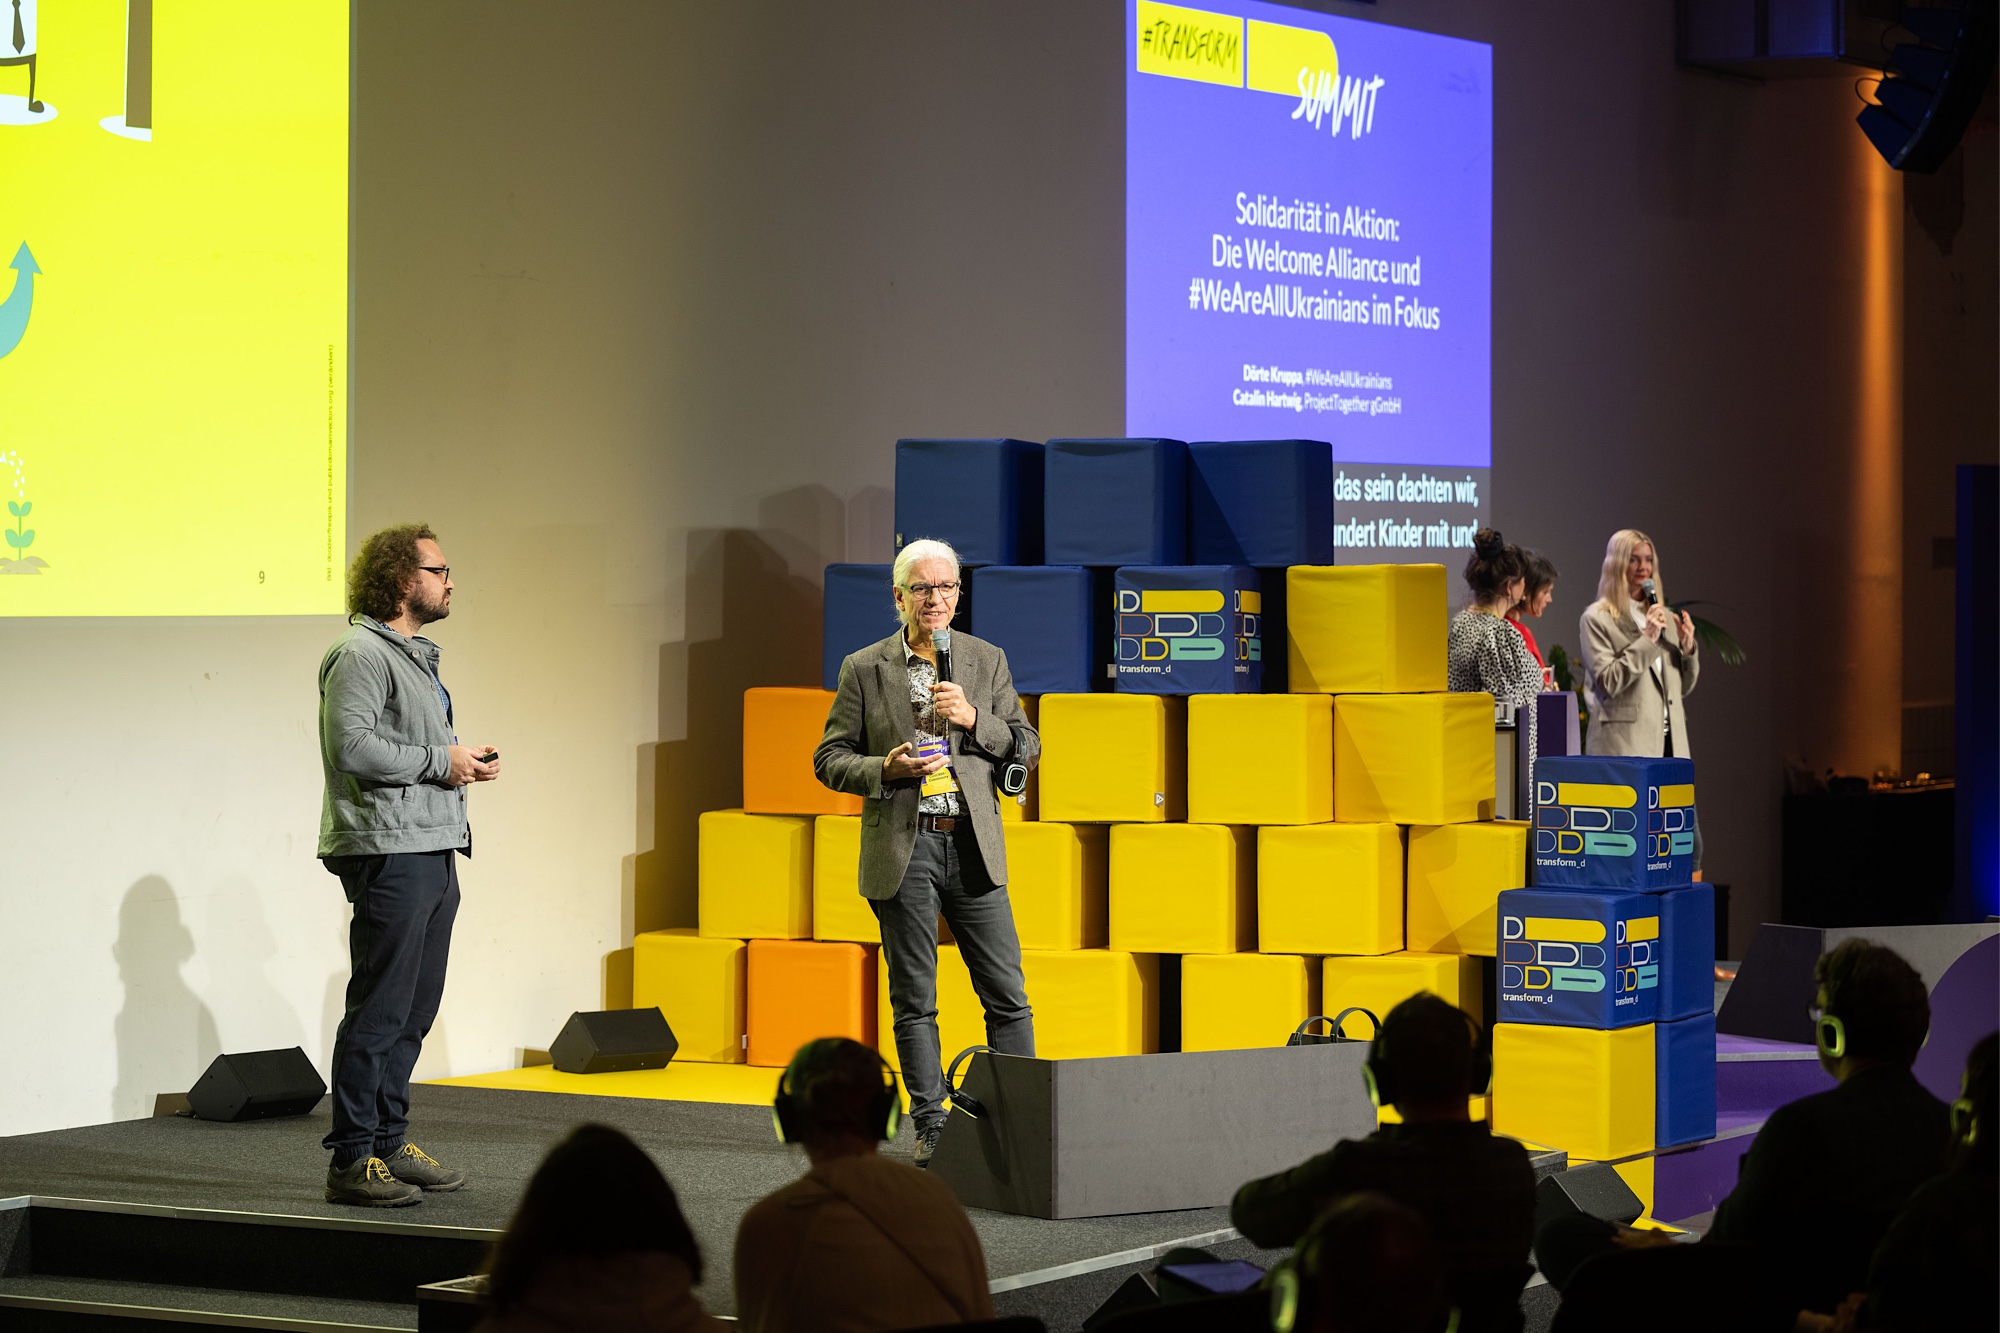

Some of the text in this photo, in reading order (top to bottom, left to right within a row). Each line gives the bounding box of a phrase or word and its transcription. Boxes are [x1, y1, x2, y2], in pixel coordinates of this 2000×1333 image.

[1142, 17, 1238, 74] #TRANSFORM
[1291, 66, 1385, 140] SUMMIT
[1235, 191, 1400, 242] Solidarität in Aktion:
[1211, 234, 1421, 286] Die Welcome Alliance und
[1189, 277, 1441, 330] #WeAreAllUkrainians im Fokus
[1243, 364, 1393, 390] Dörte Kruppa, #WeAreAllUkrainians
[1233, 388, 1265, 407] Catalin
[1304, 392, 1369, 415] ProjectTogether
[1370, 396, 1401, 416] gGmbH
[1333, 470, 1479, 508] das sein dachten wir,
[1378, 517, 1425, 547] Kinder
[1426, 519, 1450, 548] mit
[1451, 518, 1478, 548] und
[258, 570, 265, 584] 9
[1119, 664, 1171, 675] transform_d
[1536, 857, 1586, 869] transform_d
[1502, 992, 1553, 1005] transform_d
